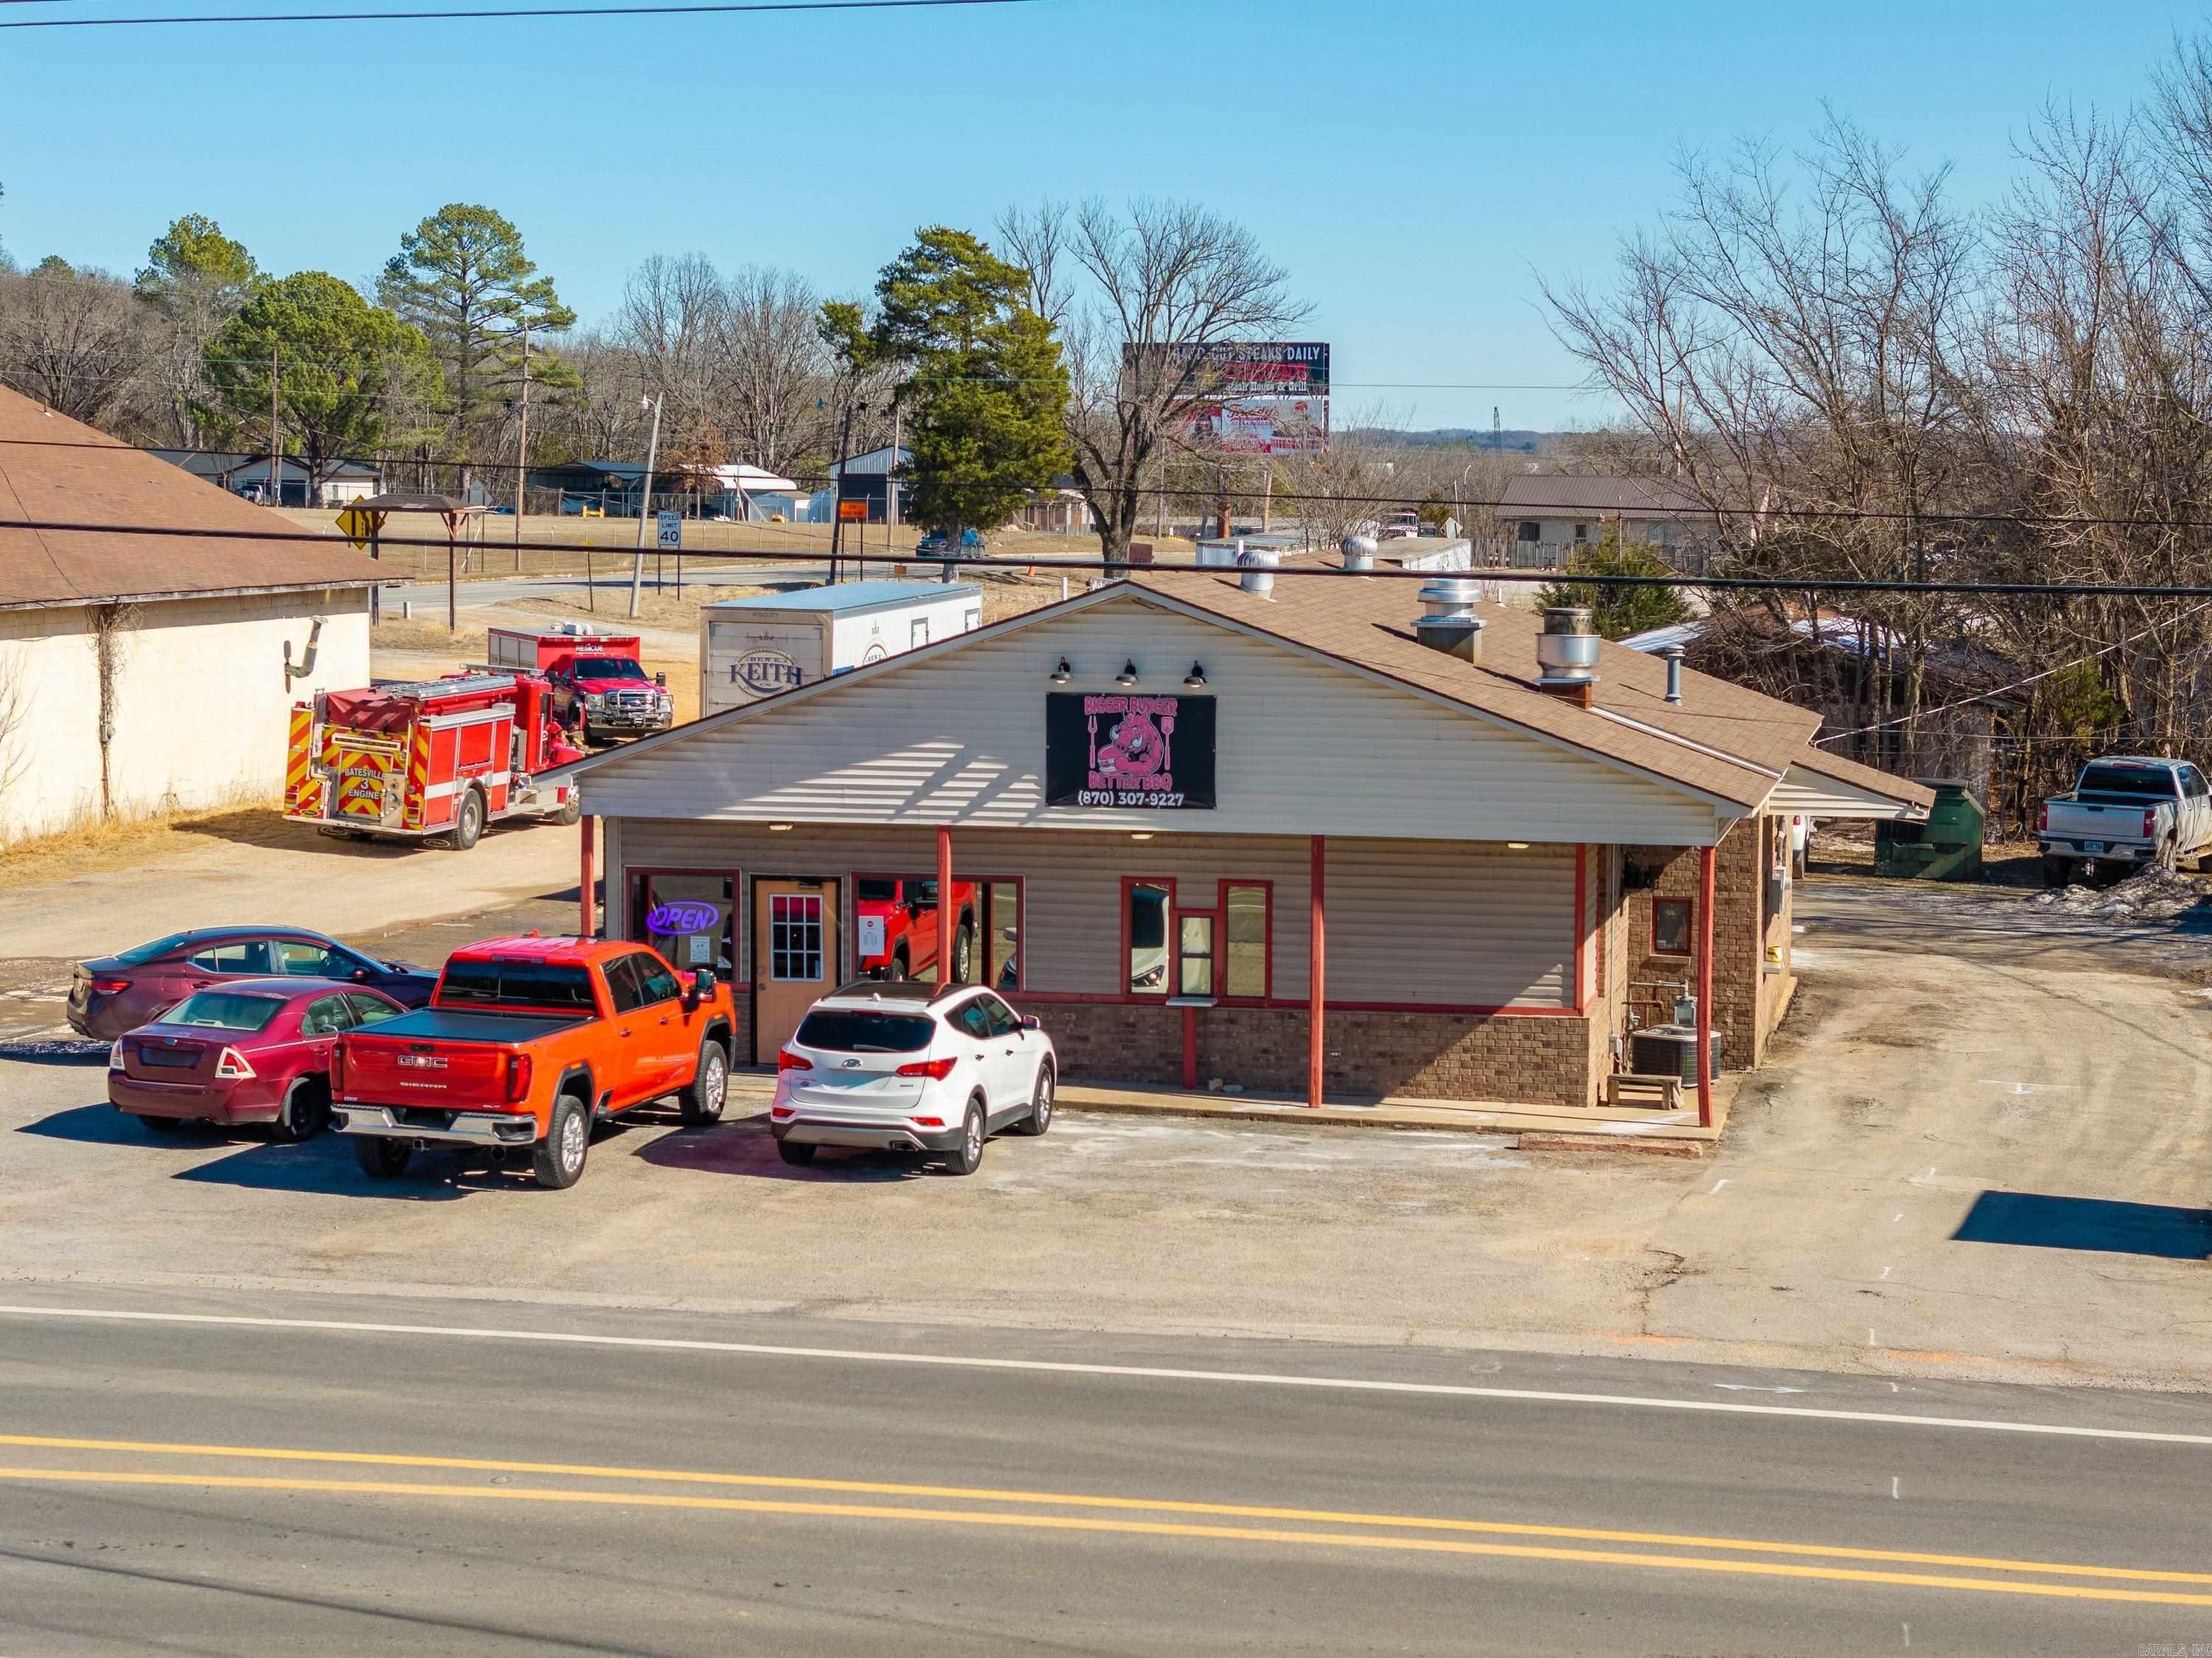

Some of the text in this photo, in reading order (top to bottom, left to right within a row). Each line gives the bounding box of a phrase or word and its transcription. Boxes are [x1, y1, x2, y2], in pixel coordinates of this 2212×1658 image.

[1239, 346, 1282, 360] STEAKS
[1287, 346, 1320, 360] DAILY
[1289, 381, 1307, 391] Grill
[661, 532, 678, 542] 40
[730, 663, 803, 686] KEITH
[1085, 696, 1178, 717] BIGGER BURGER
[344, 767, 386, 780] BATESVILLE
[361, 778, 369, 790] 3
[1088, 770, 1173, 791] BETTER BBQ
[348, 790, 380, 800] ENGINE
[1078, 790, 1184, 806] (870) 307-9227
[652, 906, 711, 930] OPEN
[398, 1055, 448, 1068] GMC
